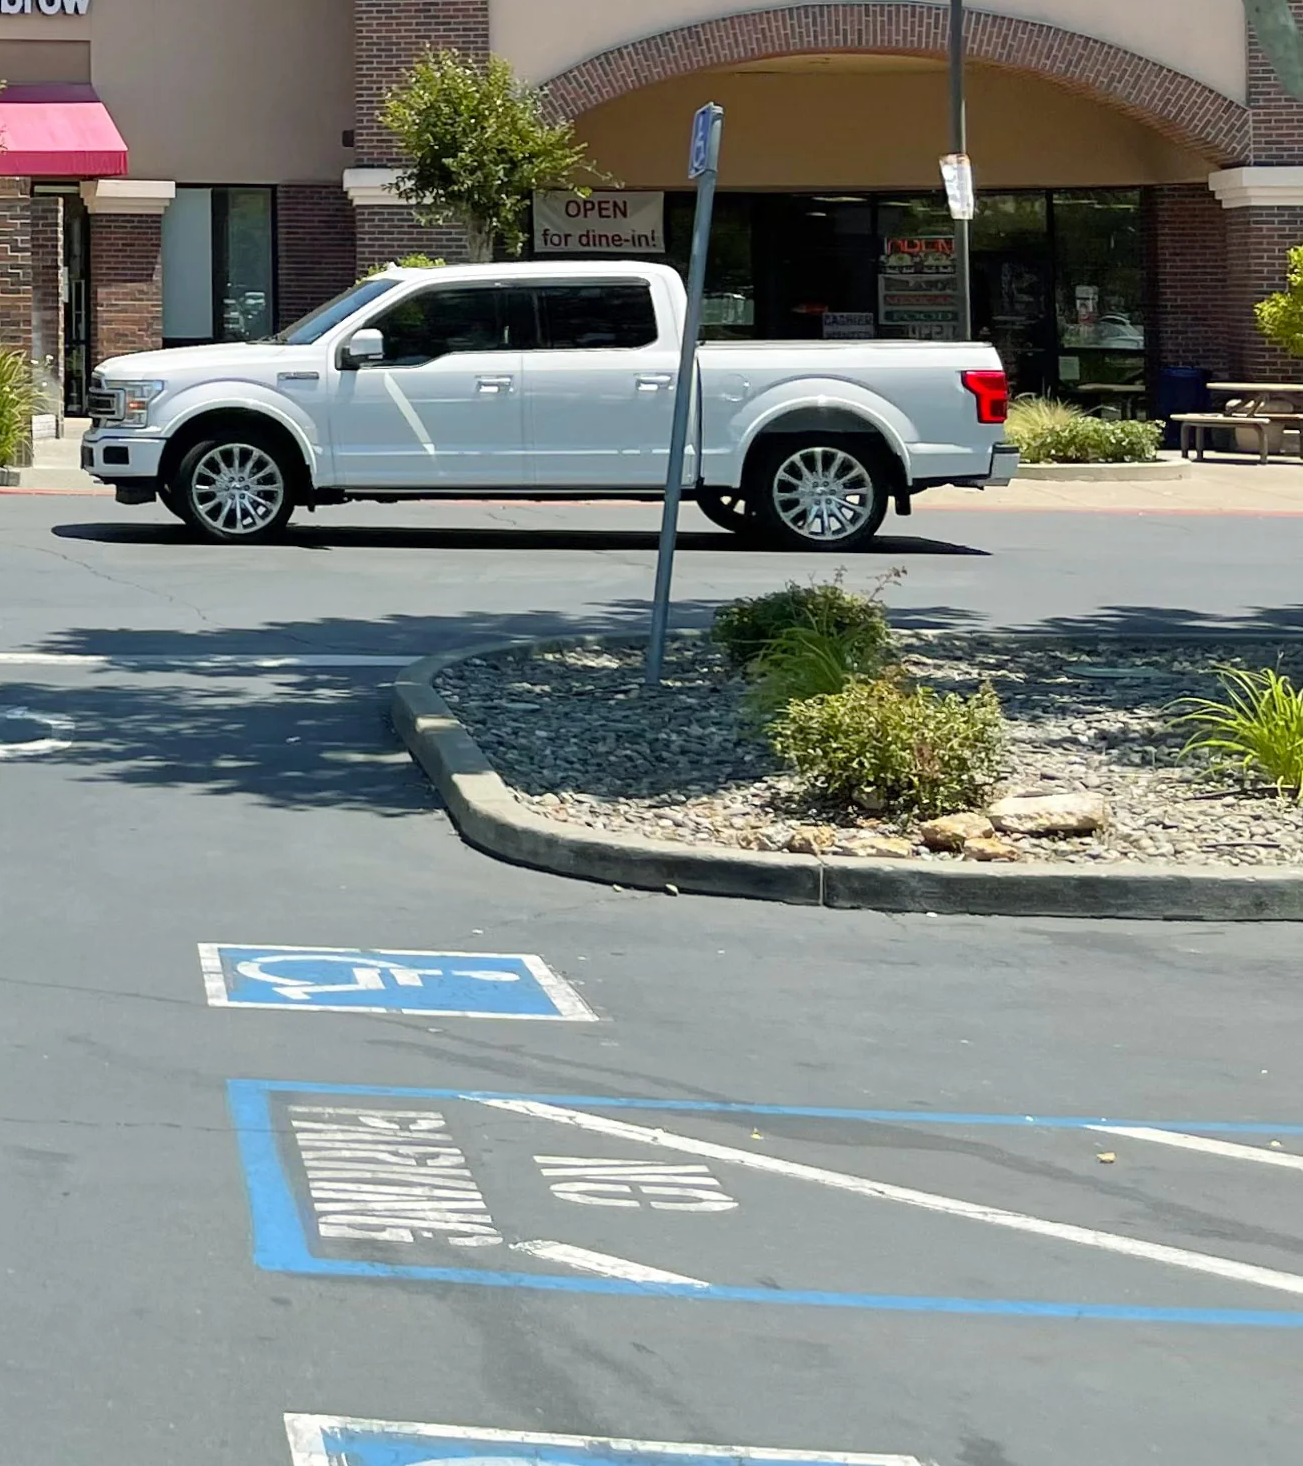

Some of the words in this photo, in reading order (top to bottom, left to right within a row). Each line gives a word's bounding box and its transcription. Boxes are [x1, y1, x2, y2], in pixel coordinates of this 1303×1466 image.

[564, 199, 629, 220] OPEN
[541, 228, 572, 248] for
[578, 228, 657, 248] dine-in!
[286, 1104, 504, 1247] PARKING
[532, 1154, 740, 1213] NO
